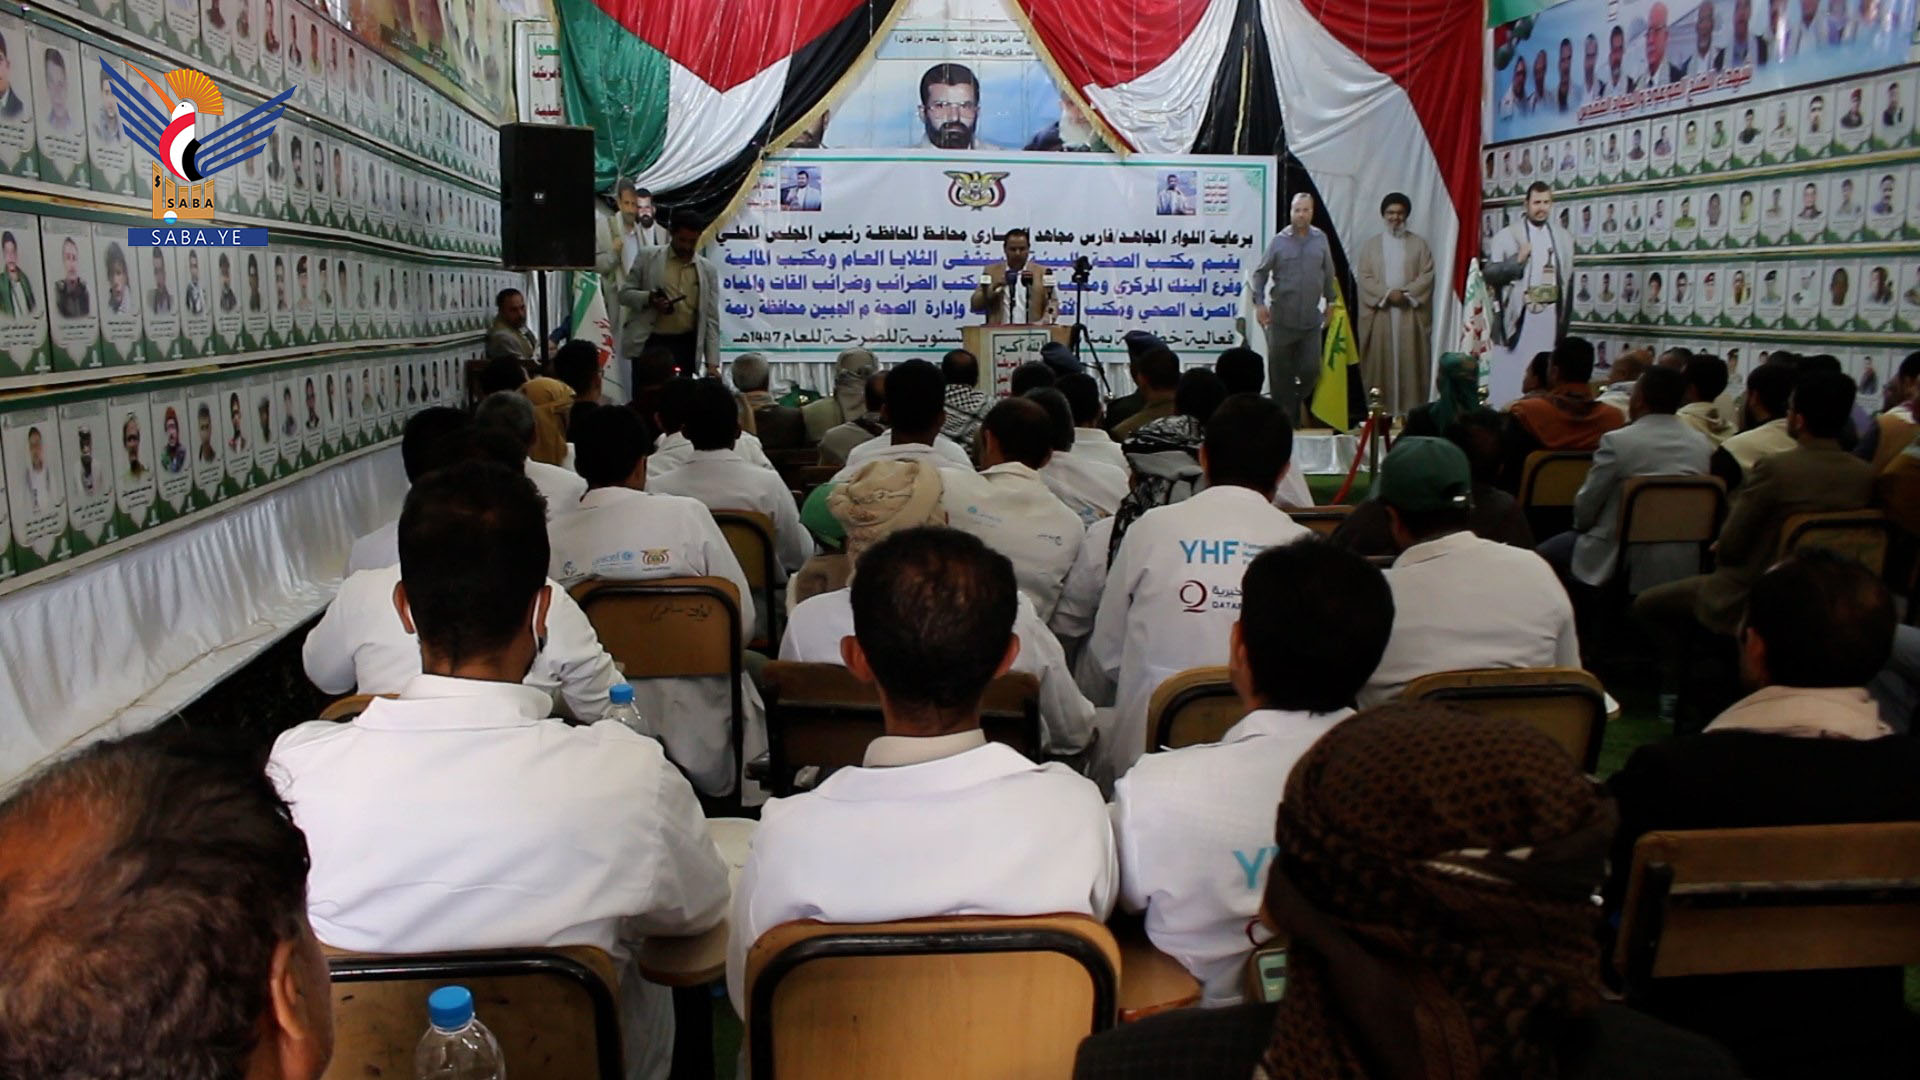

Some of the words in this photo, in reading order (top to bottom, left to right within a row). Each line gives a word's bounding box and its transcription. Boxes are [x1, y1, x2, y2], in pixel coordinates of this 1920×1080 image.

[765, 225, 813, 243] المجلس
[818, 224, 861, 244] رئيس
[922, 225, 967, 242] محافظ
[1034, 227, 1075, 244] مجاهد
[1171, 229, 1206, 246] اللواء
[1210, 229, 1254, 248] برعاية
[724, 248, 771, 270] المالية
[776, 248, 837, 270] ومكتب
[842, 248, 884, 270] العام
[1092, 252, 1140, 269] الصحة
[1145, 252, 1195, 272] مكتب
[1202, 252, 1241, 275] يقيم
[723, 274, 765, 294] والمياه
[770, 274, 808, 290] القات
[812, 272, 872, 294] وضرائب
[876, 272, 937, 293] الضرائب
[1113, 275, 1163, 299] المركزي
[1167, 276, 1208, 297] البنك
[1212, 277, 1242, 297] وفرع
[724, 298, 755, 319] ريمة
[758, 298, 807, 315] محافظة
[809, 299, 855, 319] الجبين
[858, 303, 870, 320] م
[874, 299, 917, 316] الصحة
[924, 299, 966, 319] وإدارة
[1084, 299, 1135, 319] ومكتب
[1138, 302, 1186, 324] الصحي
[782, 328, 822, 347] للعام
[823, 327, 899, 346] للصرخة
[1184, 329, 1235, 349] فعالية
[1179, 540, 1239, 565] YHF
